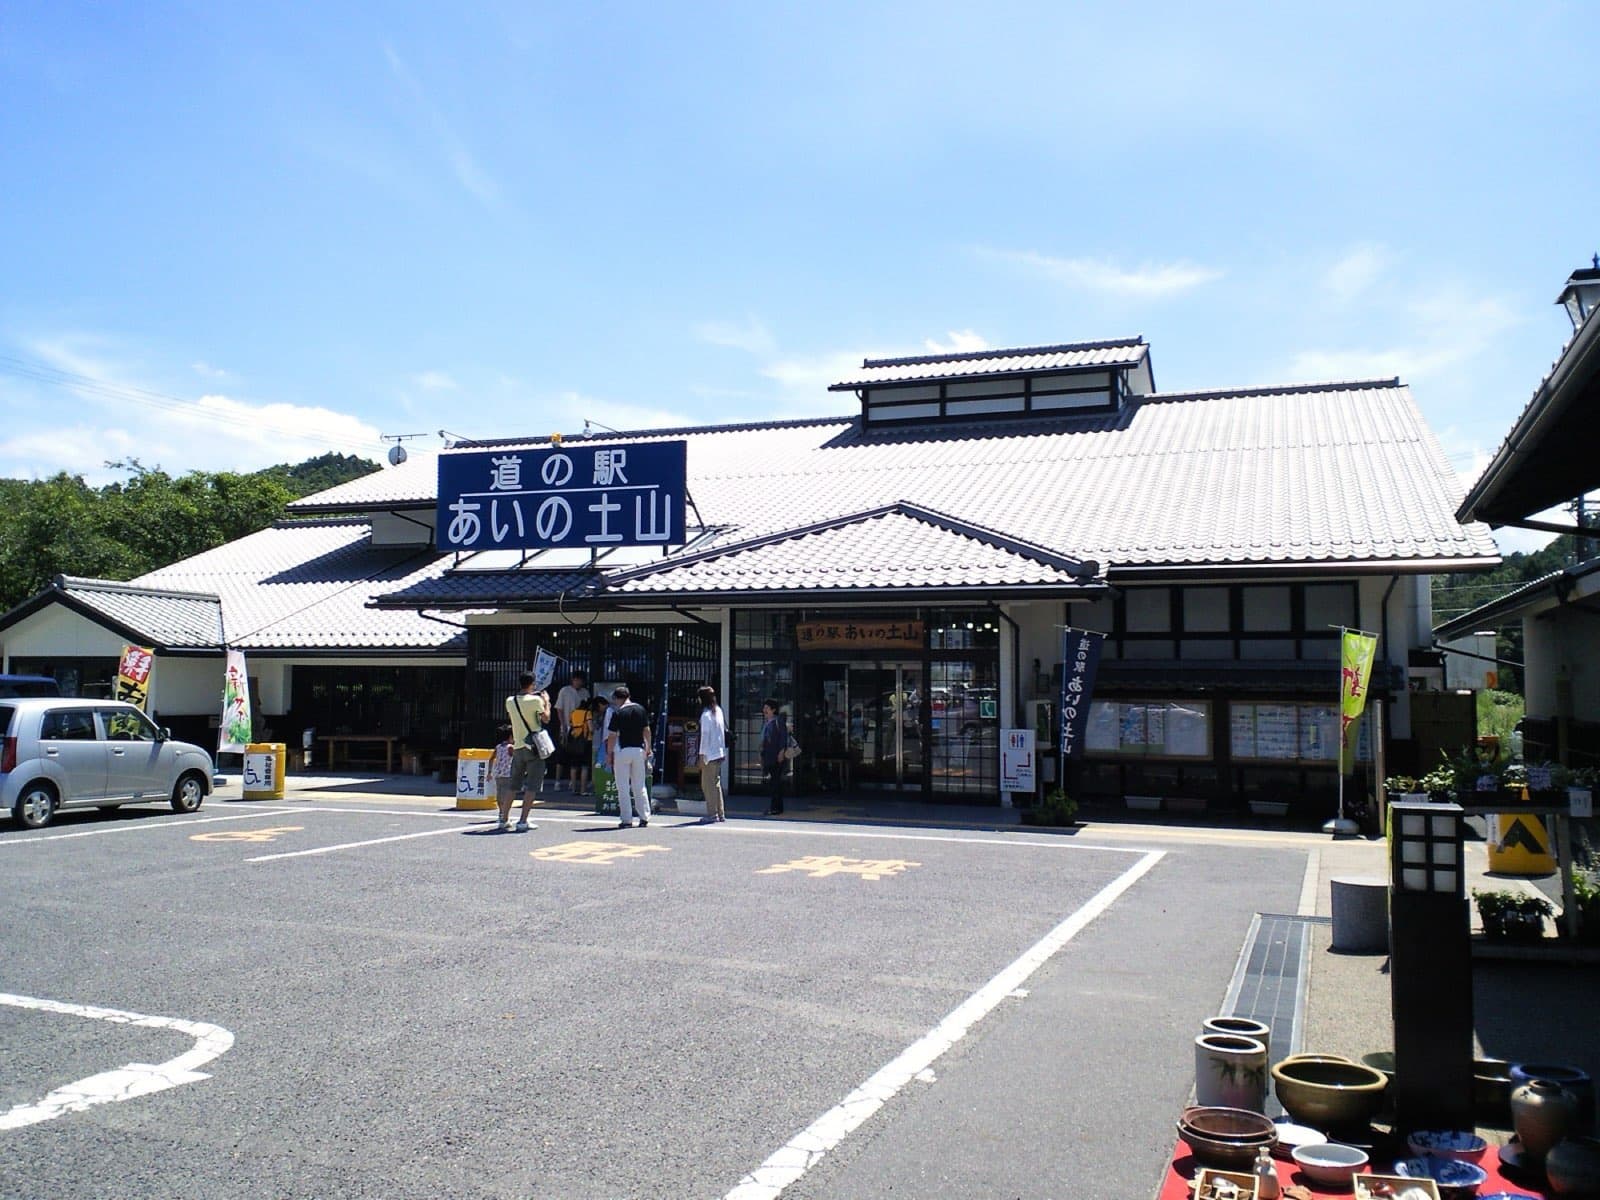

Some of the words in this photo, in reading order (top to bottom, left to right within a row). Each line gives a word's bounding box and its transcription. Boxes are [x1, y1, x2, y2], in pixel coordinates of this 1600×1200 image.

[490, 449, 628, 491] 道の駅
[447, 489, 671, 546] あいの土山
[802, 625, 842, 641] 道の駅
[845, 624, 919, 640] あいの土山
